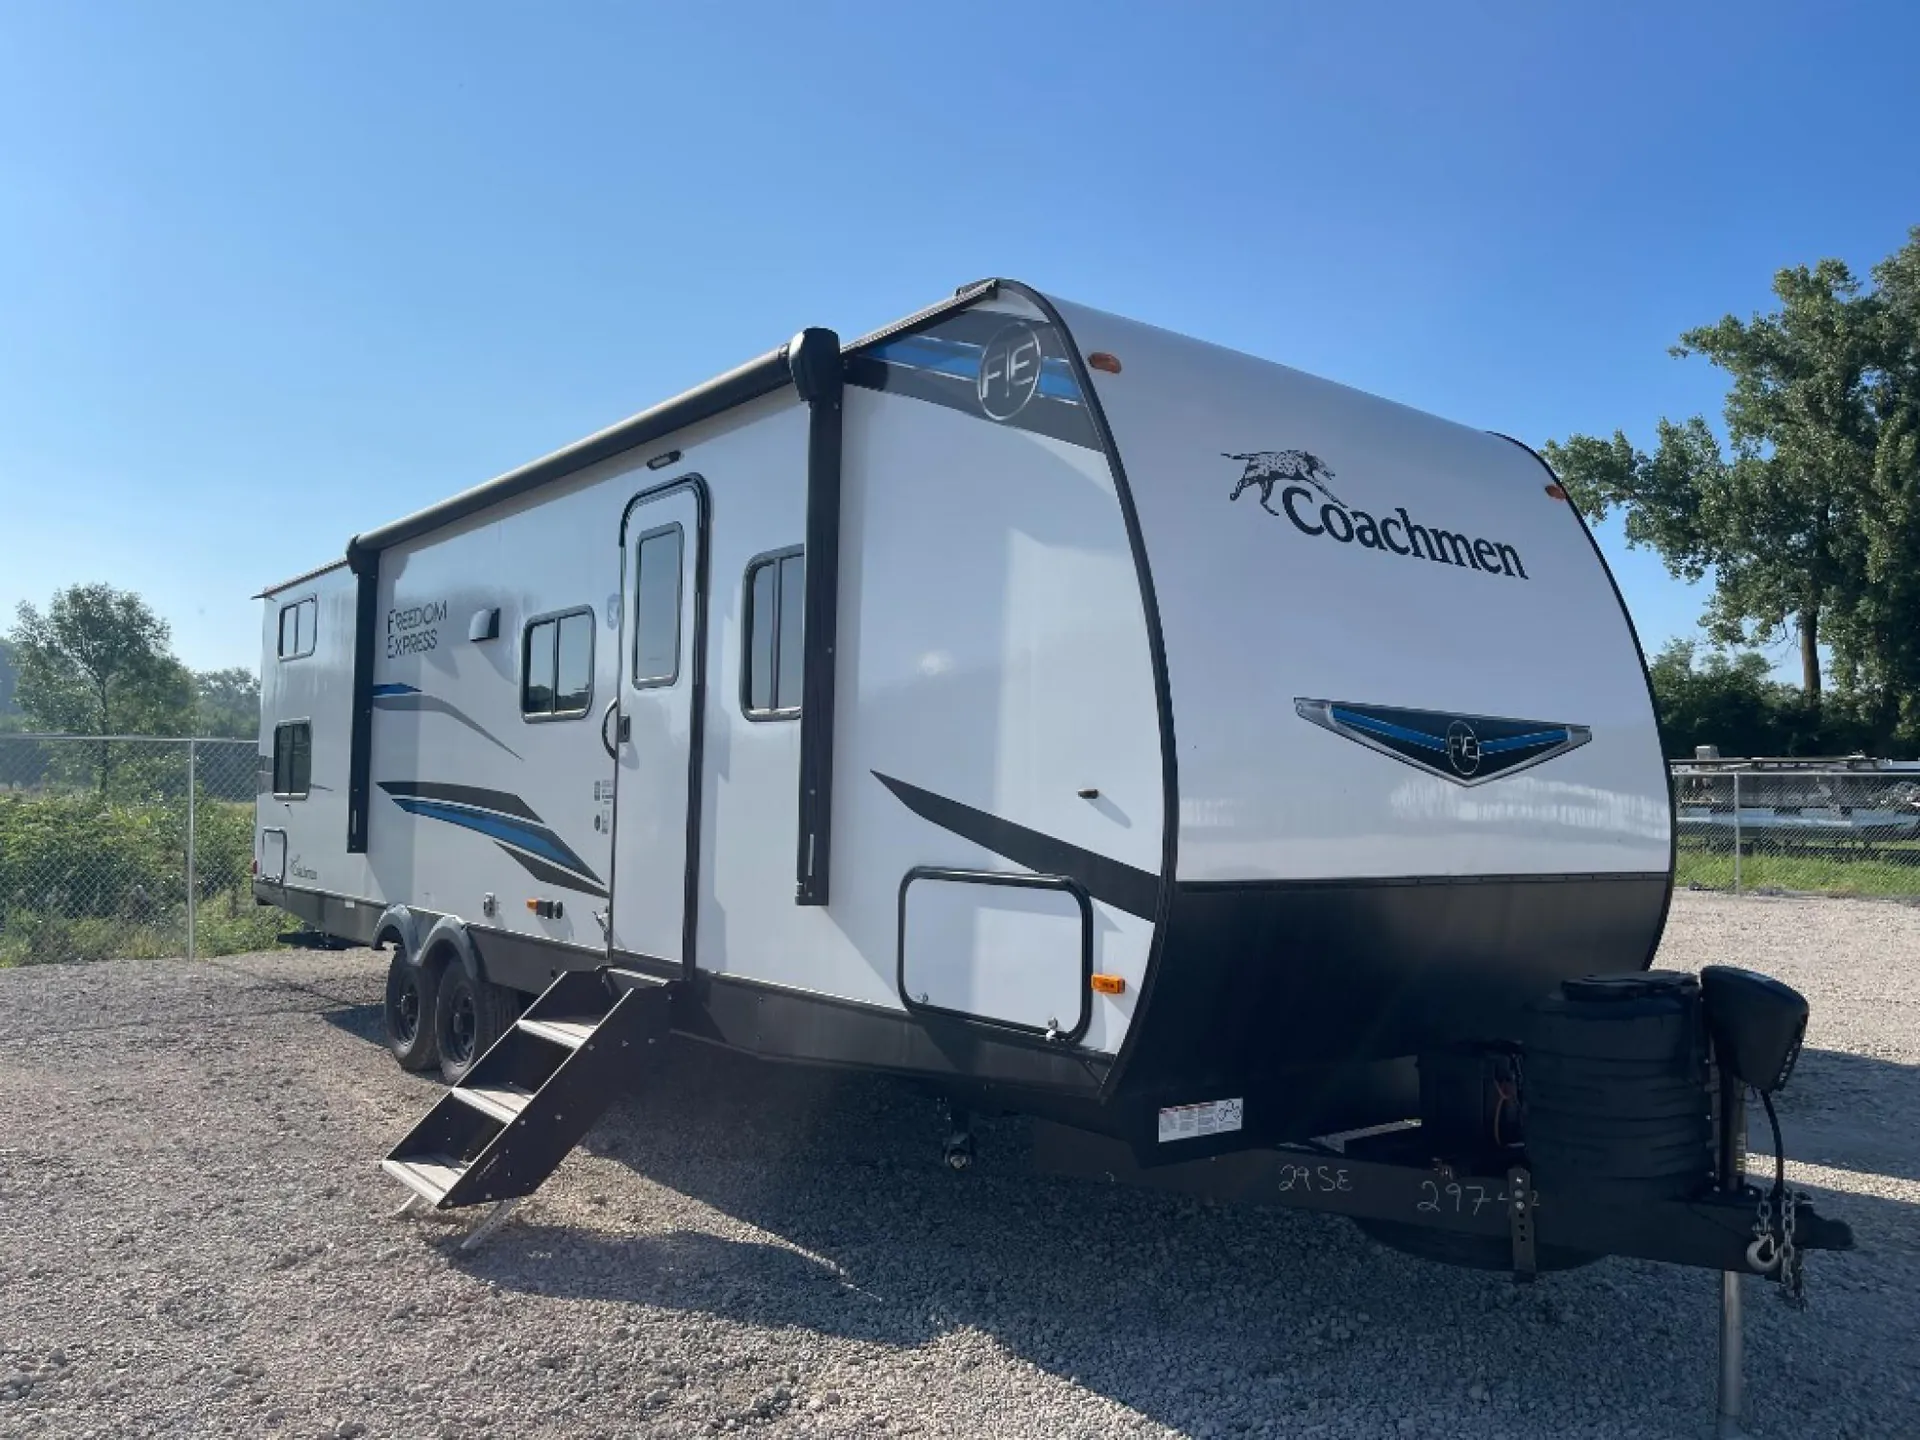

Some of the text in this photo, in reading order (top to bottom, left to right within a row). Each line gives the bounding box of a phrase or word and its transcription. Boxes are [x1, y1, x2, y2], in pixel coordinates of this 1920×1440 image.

[1282, 486, 1529, 580] Coachmen
[386, 599, 448, 635] FREEDOM
[386, 628, 438, 659] EXPRESS
